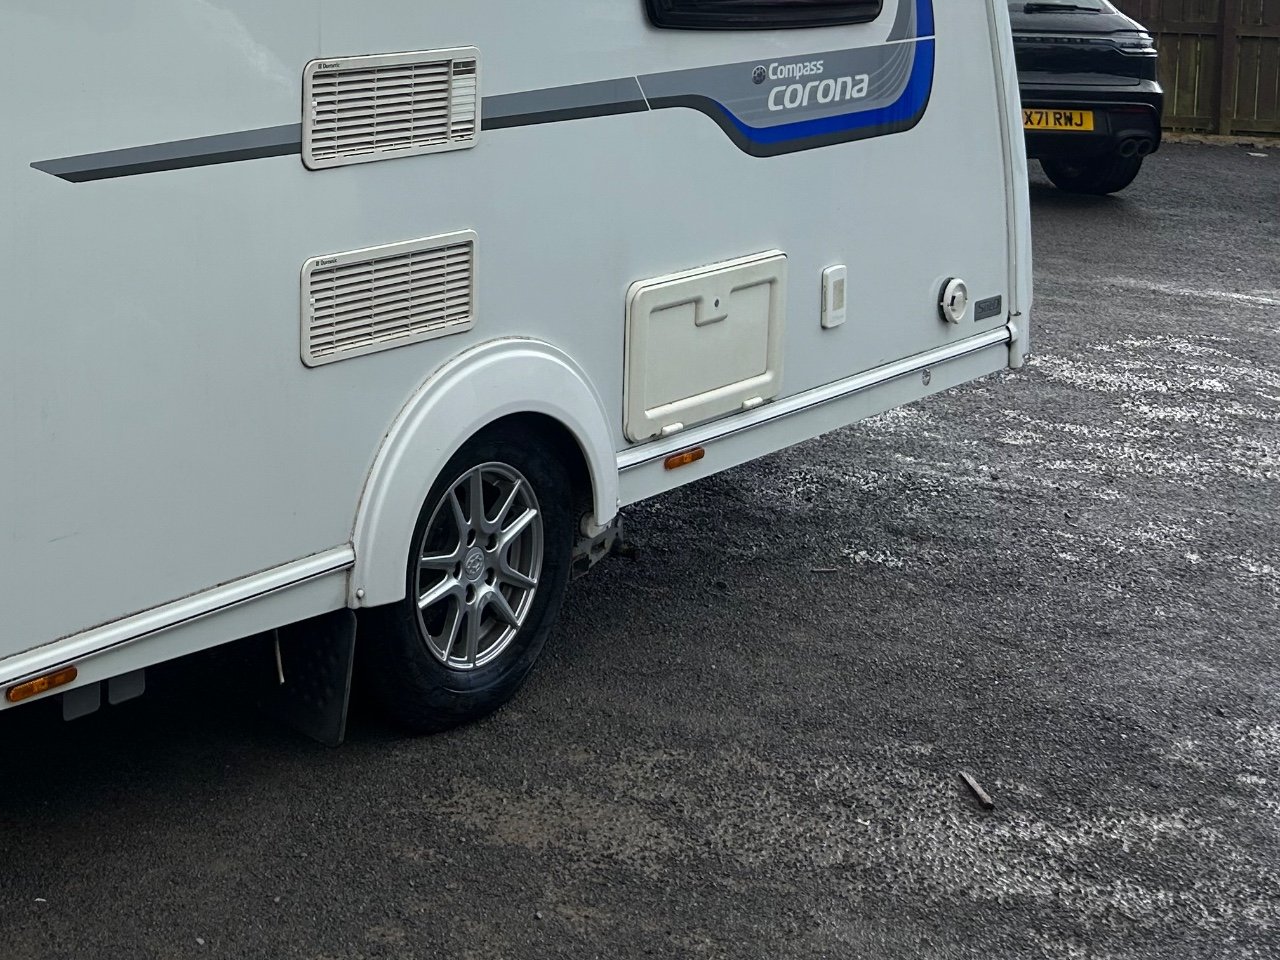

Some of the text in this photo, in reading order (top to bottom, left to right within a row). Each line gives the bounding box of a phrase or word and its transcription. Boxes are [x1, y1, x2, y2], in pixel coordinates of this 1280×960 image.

[769, 59, 824, 81] Compass
[767, 73, 869, 111] corona
[1024, 110, 1083, 127] X71 RWJ
